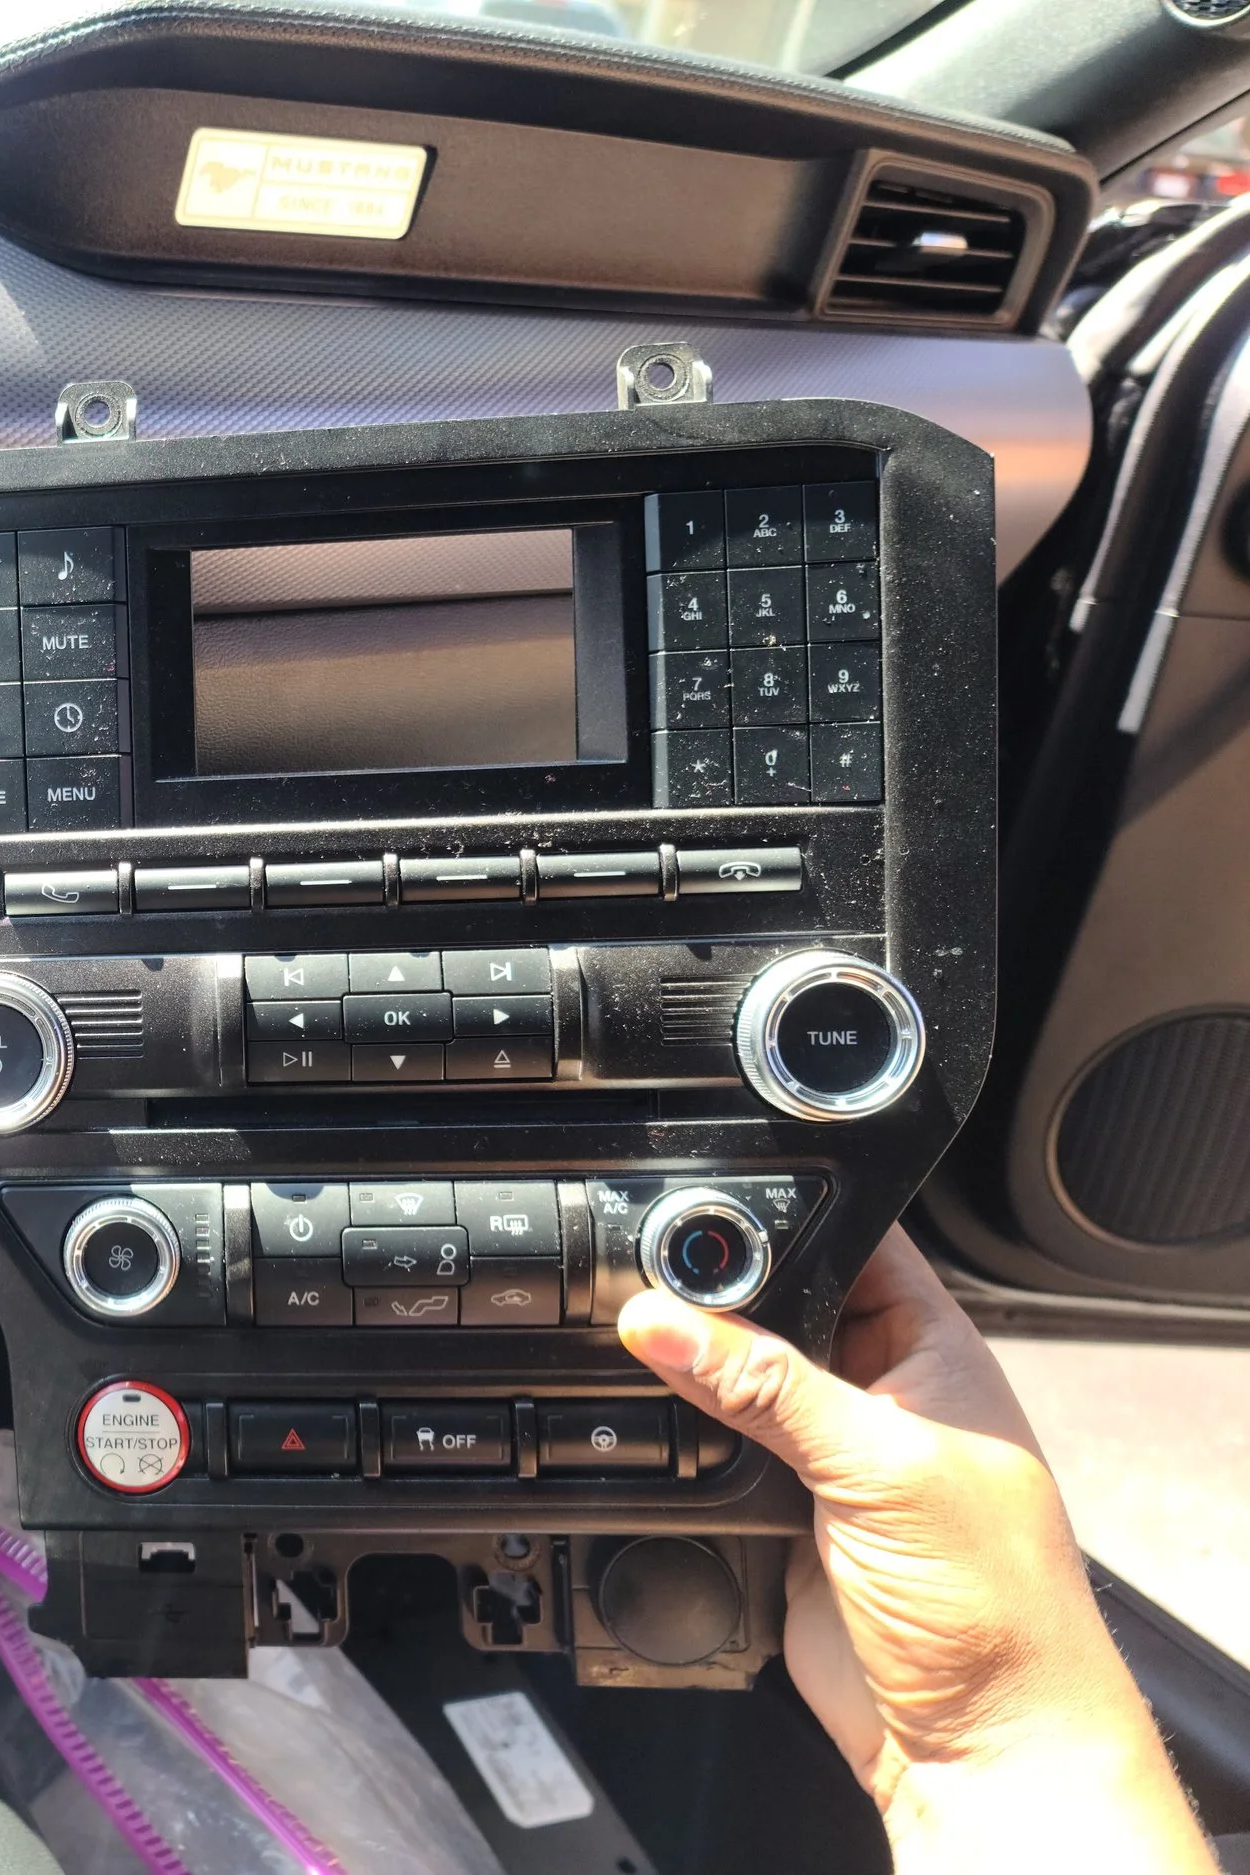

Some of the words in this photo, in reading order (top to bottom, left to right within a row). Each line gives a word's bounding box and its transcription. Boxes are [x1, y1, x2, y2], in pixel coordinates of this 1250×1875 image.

[759, 514, 769, 528] 2
[834, 509, 845, 524] 3
[685, 521, 694, 535] 1
[753, 527, 777, 538] ABC
[829, 523, 851, 534] DEF
[761, 594, 771, 608] 5
[836, 589, 847, 604] 6
[688, 597, 698, 612] 4
[829, 603, 856, 614] MNO
[683, 611, 703, 621] GHI
[756, 608, 775, 618] JKL
[43, 634, 89, 651] MUTE
[763, 672, 774, 687] 8
[838, 669, 849, 684] 9
[692, 677, 702, 692] 7
[827, 683, 860, 693] WXYZ
[682, 691, 711, 701] PQRS
[758, 687, 780, 697] TUV
[47, 786, 96, 802] MENU
[384, 1011, 410, 1026] OK
[807, 1031, 858, 1045] TUNE
[598, 1190, 629, 1203] MAX
[765, 1187, 797, 1199] MAX
[603, 1202, 628, 1215] A/C
[287, 1291, 320, 1306] A/C
[102, 1413, 160, 1427] ENGINE
[86, 1436, 178, 1451] START/STOP
[442, 1435, 476, 1449] OFF
